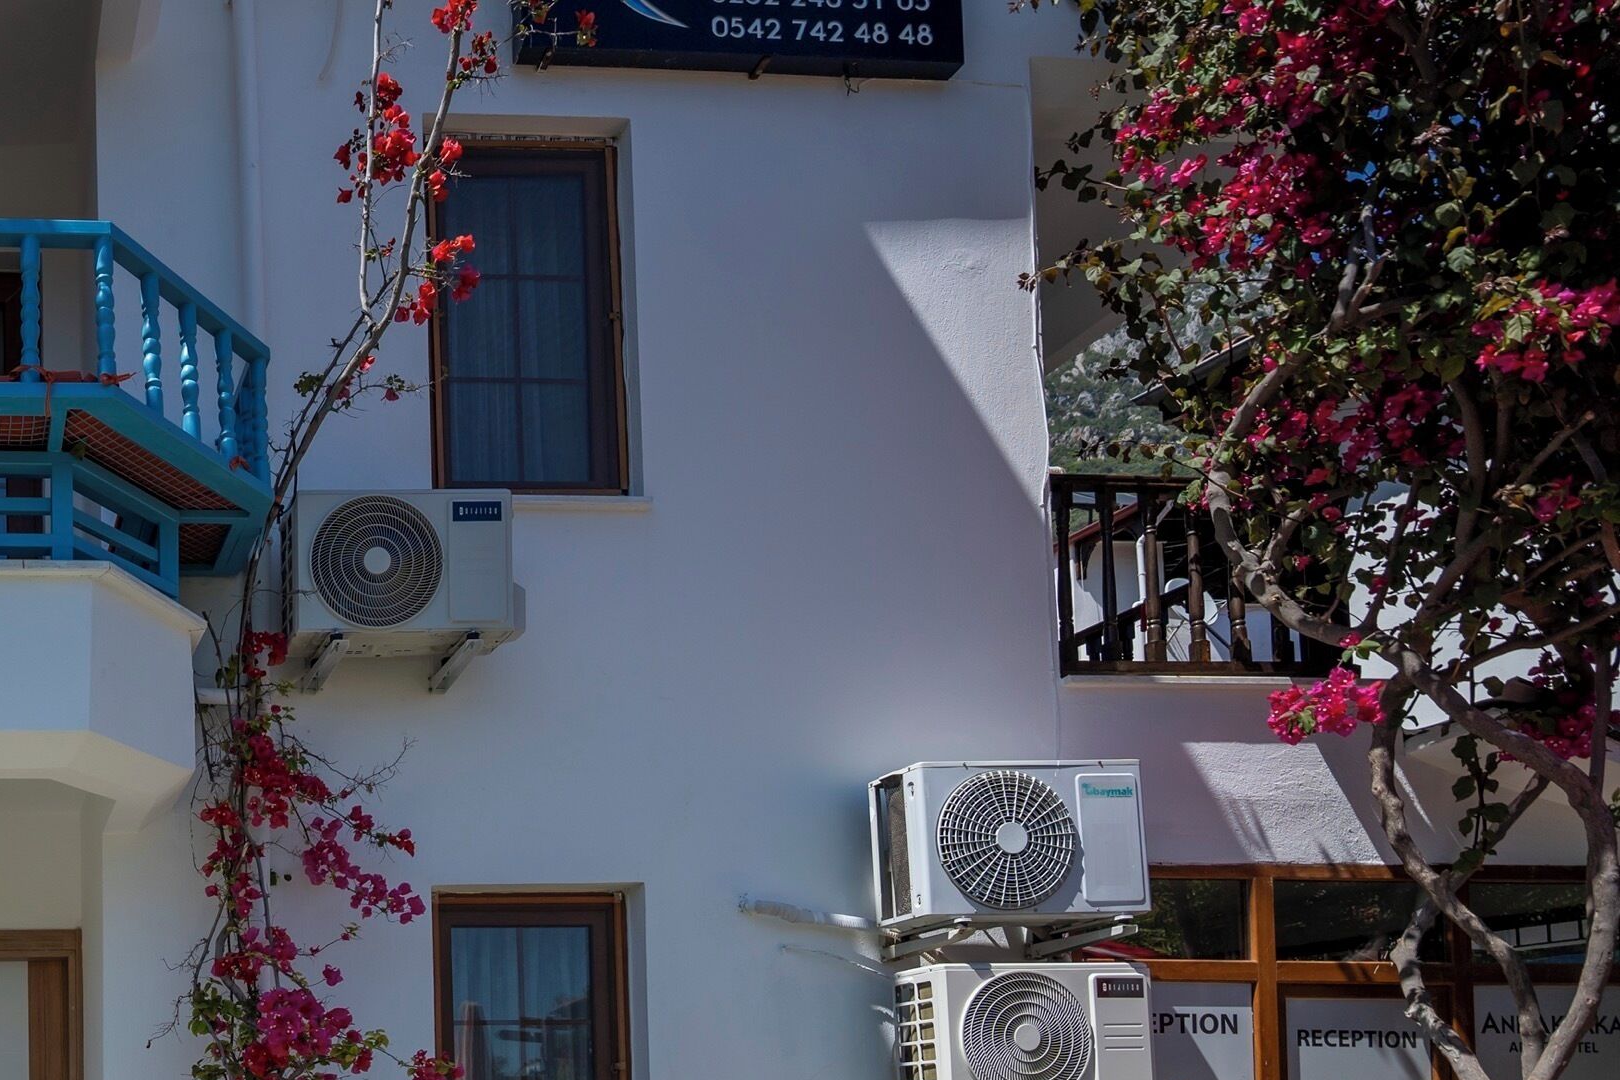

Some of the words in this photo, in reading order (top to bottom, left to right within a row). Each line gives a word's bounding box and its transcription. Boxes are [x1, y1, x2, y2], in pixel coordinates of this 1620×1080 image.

[712, 16, 782, 39] 0542
[792, 19, 845, 42] 742
[854, 22, 889, 44] 48
[898, 23, 933, 46] 48
[1297, 1029, 1417, 1049] RECEPTION
